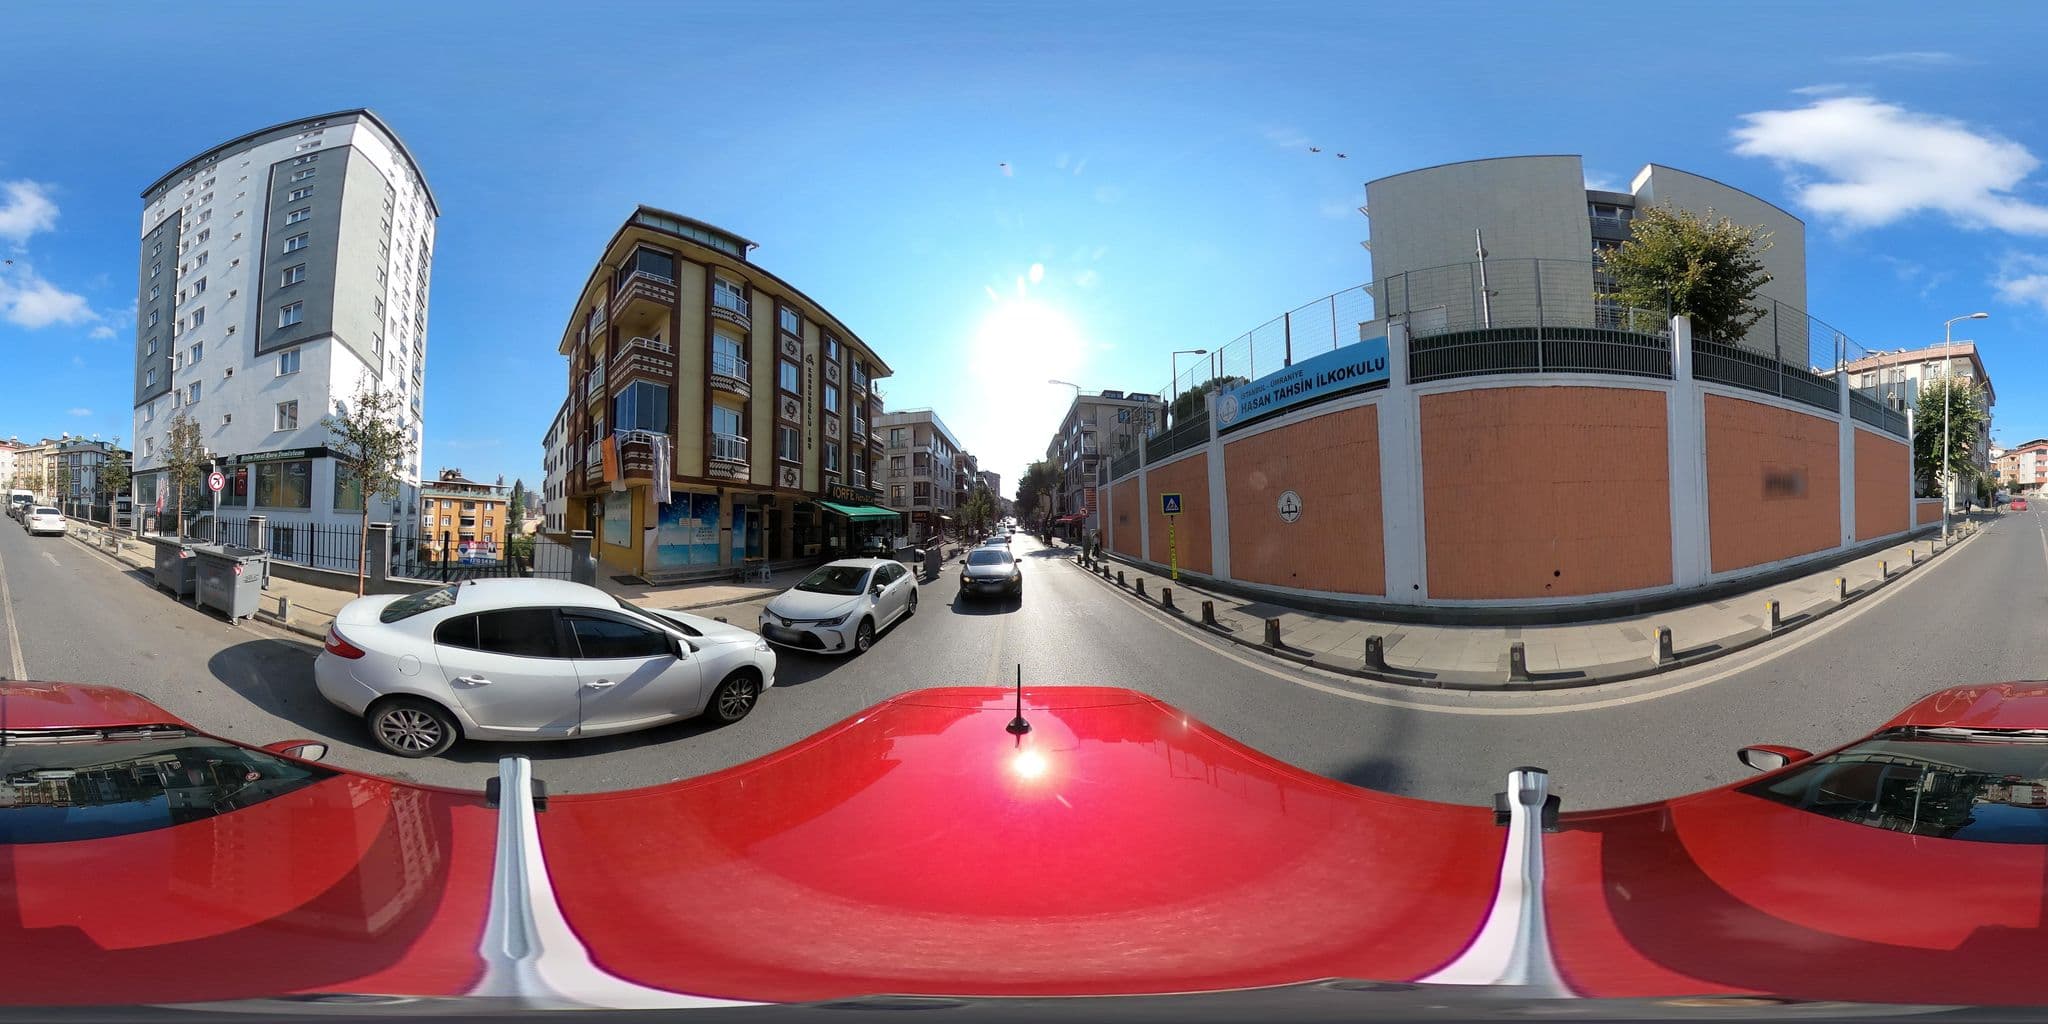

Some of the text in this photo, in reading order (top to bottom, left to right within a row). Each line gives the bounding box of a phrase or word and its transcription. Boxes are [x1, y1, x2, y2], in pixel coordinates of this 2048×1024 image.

[1241, 384, 1265, 399] İSTANBUL
[1271, 369, 1304, 386] ÜMRANİYE
[1241, 357, 1385, 414] HASAN TAHSİN İLKOKULU
